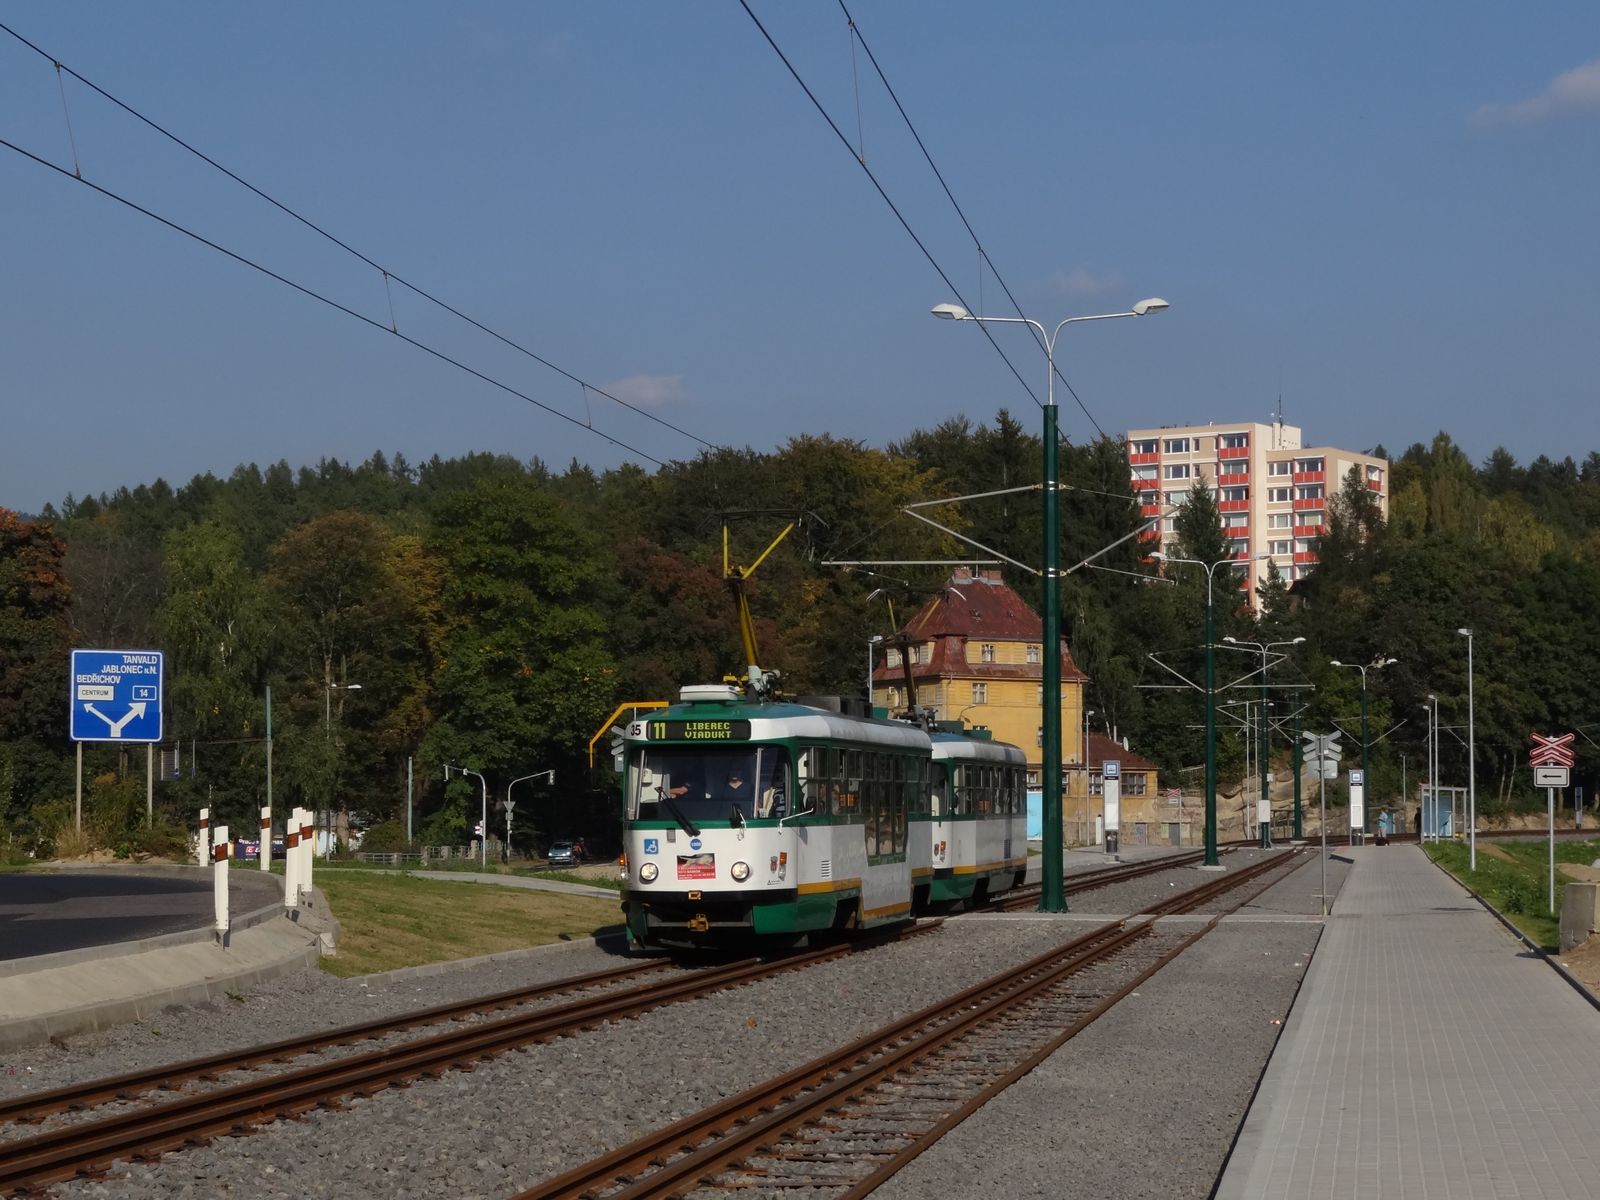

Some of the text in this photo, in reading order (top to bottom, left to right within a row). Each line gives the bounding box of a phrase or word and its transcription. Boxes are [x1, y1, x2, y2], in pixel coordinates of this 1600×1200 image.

[123, 655, 157, 664] TANVALD
[101, 665, 143, 674] JABLONEC
[76, 673, 121, 684] BEDŘICHOV
[139, 688, 149, 697] 14
[654, 722, 666, 739] 11
[686, 722, 731, 730] LIBEREC
[684, 731, 732, 739] VIADUKT
